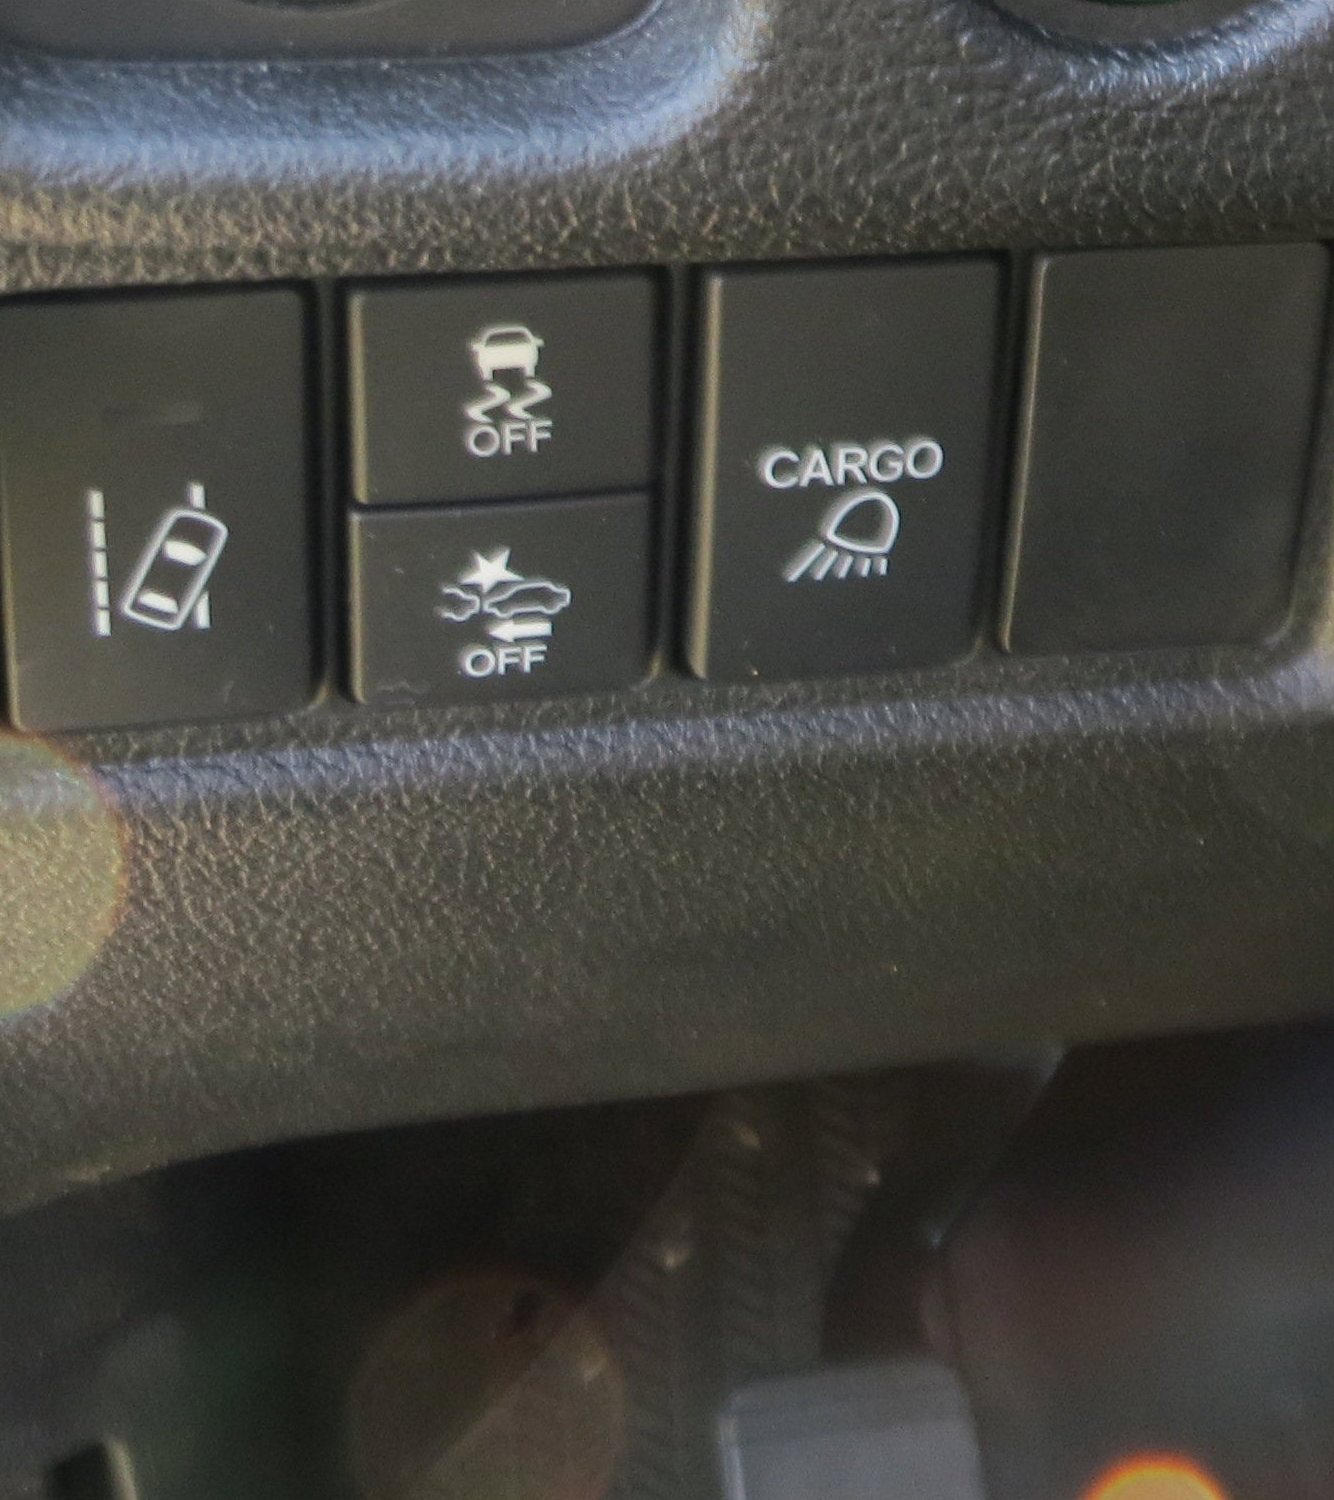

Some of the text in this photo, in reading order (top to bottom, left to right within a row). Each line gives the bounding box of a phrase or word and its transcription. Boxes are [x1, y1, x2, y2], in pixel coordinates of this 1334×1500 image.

[466, 421, 552, 457] OFF
[761, 438, 943, 489] CARGO
[462, 644, 547, 678] OFF
